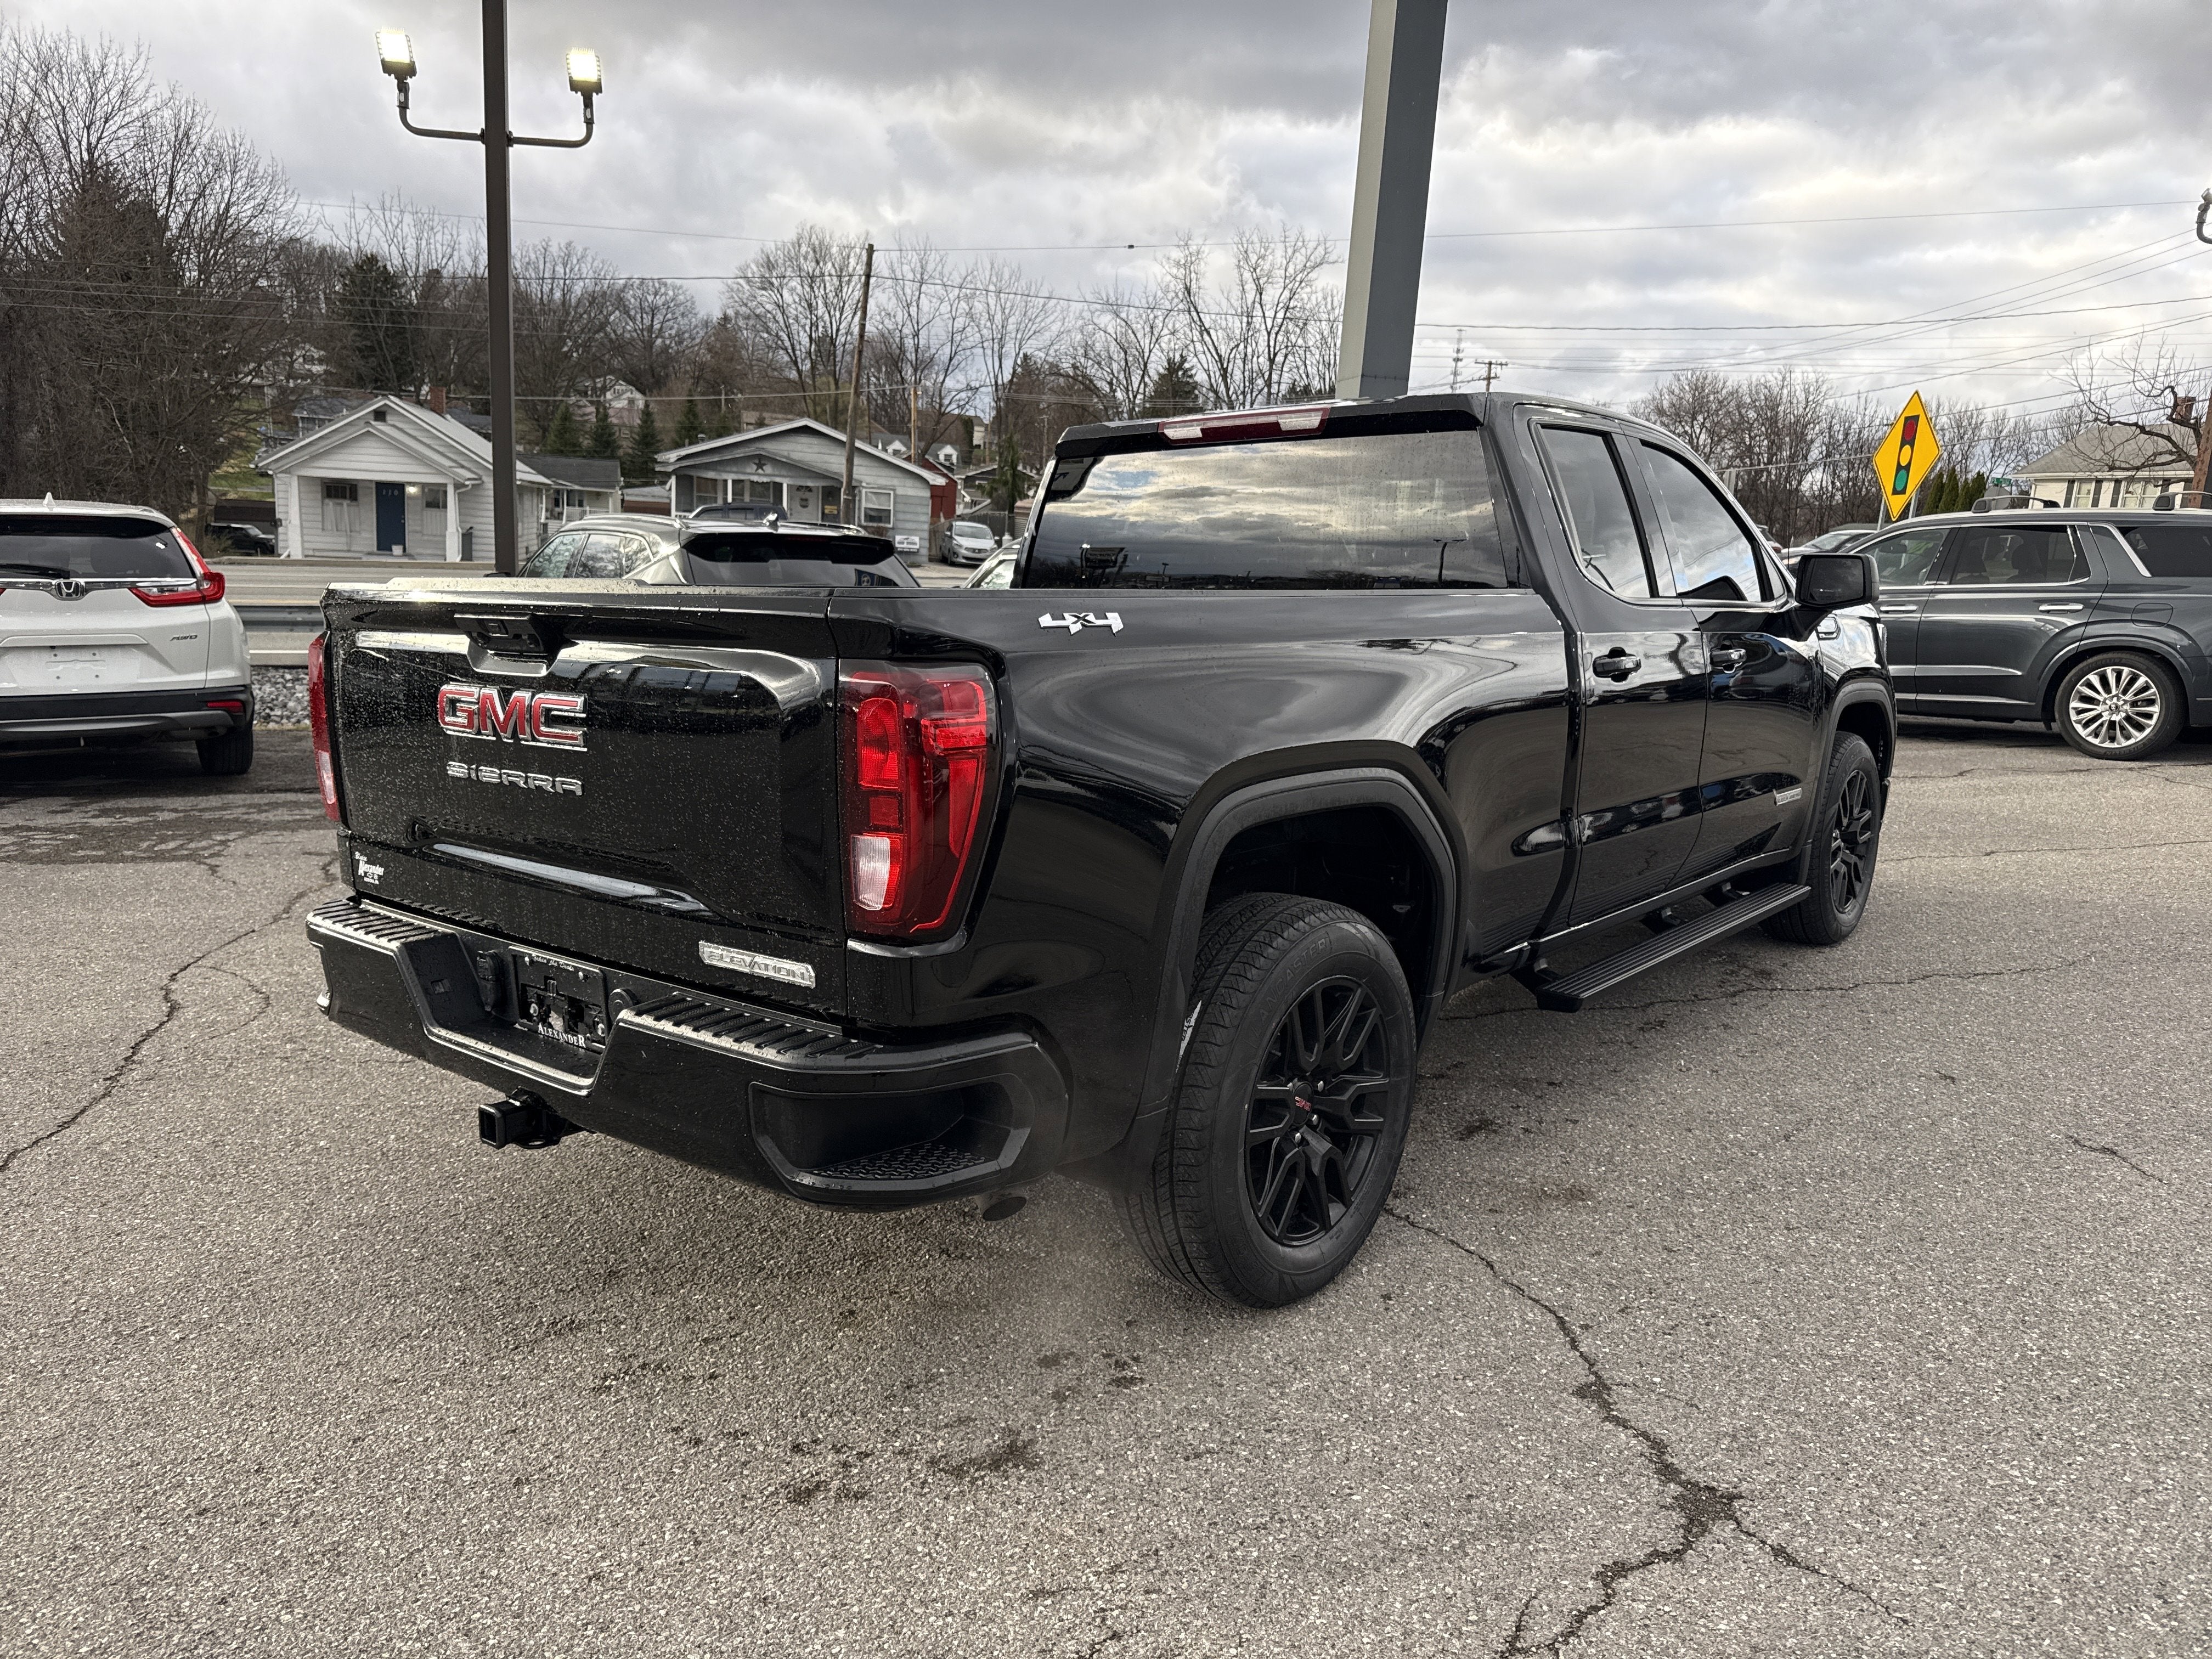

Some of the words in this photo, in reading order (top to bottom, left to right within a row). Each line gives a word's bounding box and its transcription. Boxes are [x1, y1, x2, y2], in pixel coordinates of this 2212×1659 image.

[438, 682, 588, 748] GMC
[446, 761, 584, 797] SIERRA
[704, 947, 805, 981] ELEVATION
[1251, 936, 1329, 1040] LANCASTER
[538, 1022, 586, 1048] ALEXANDER
